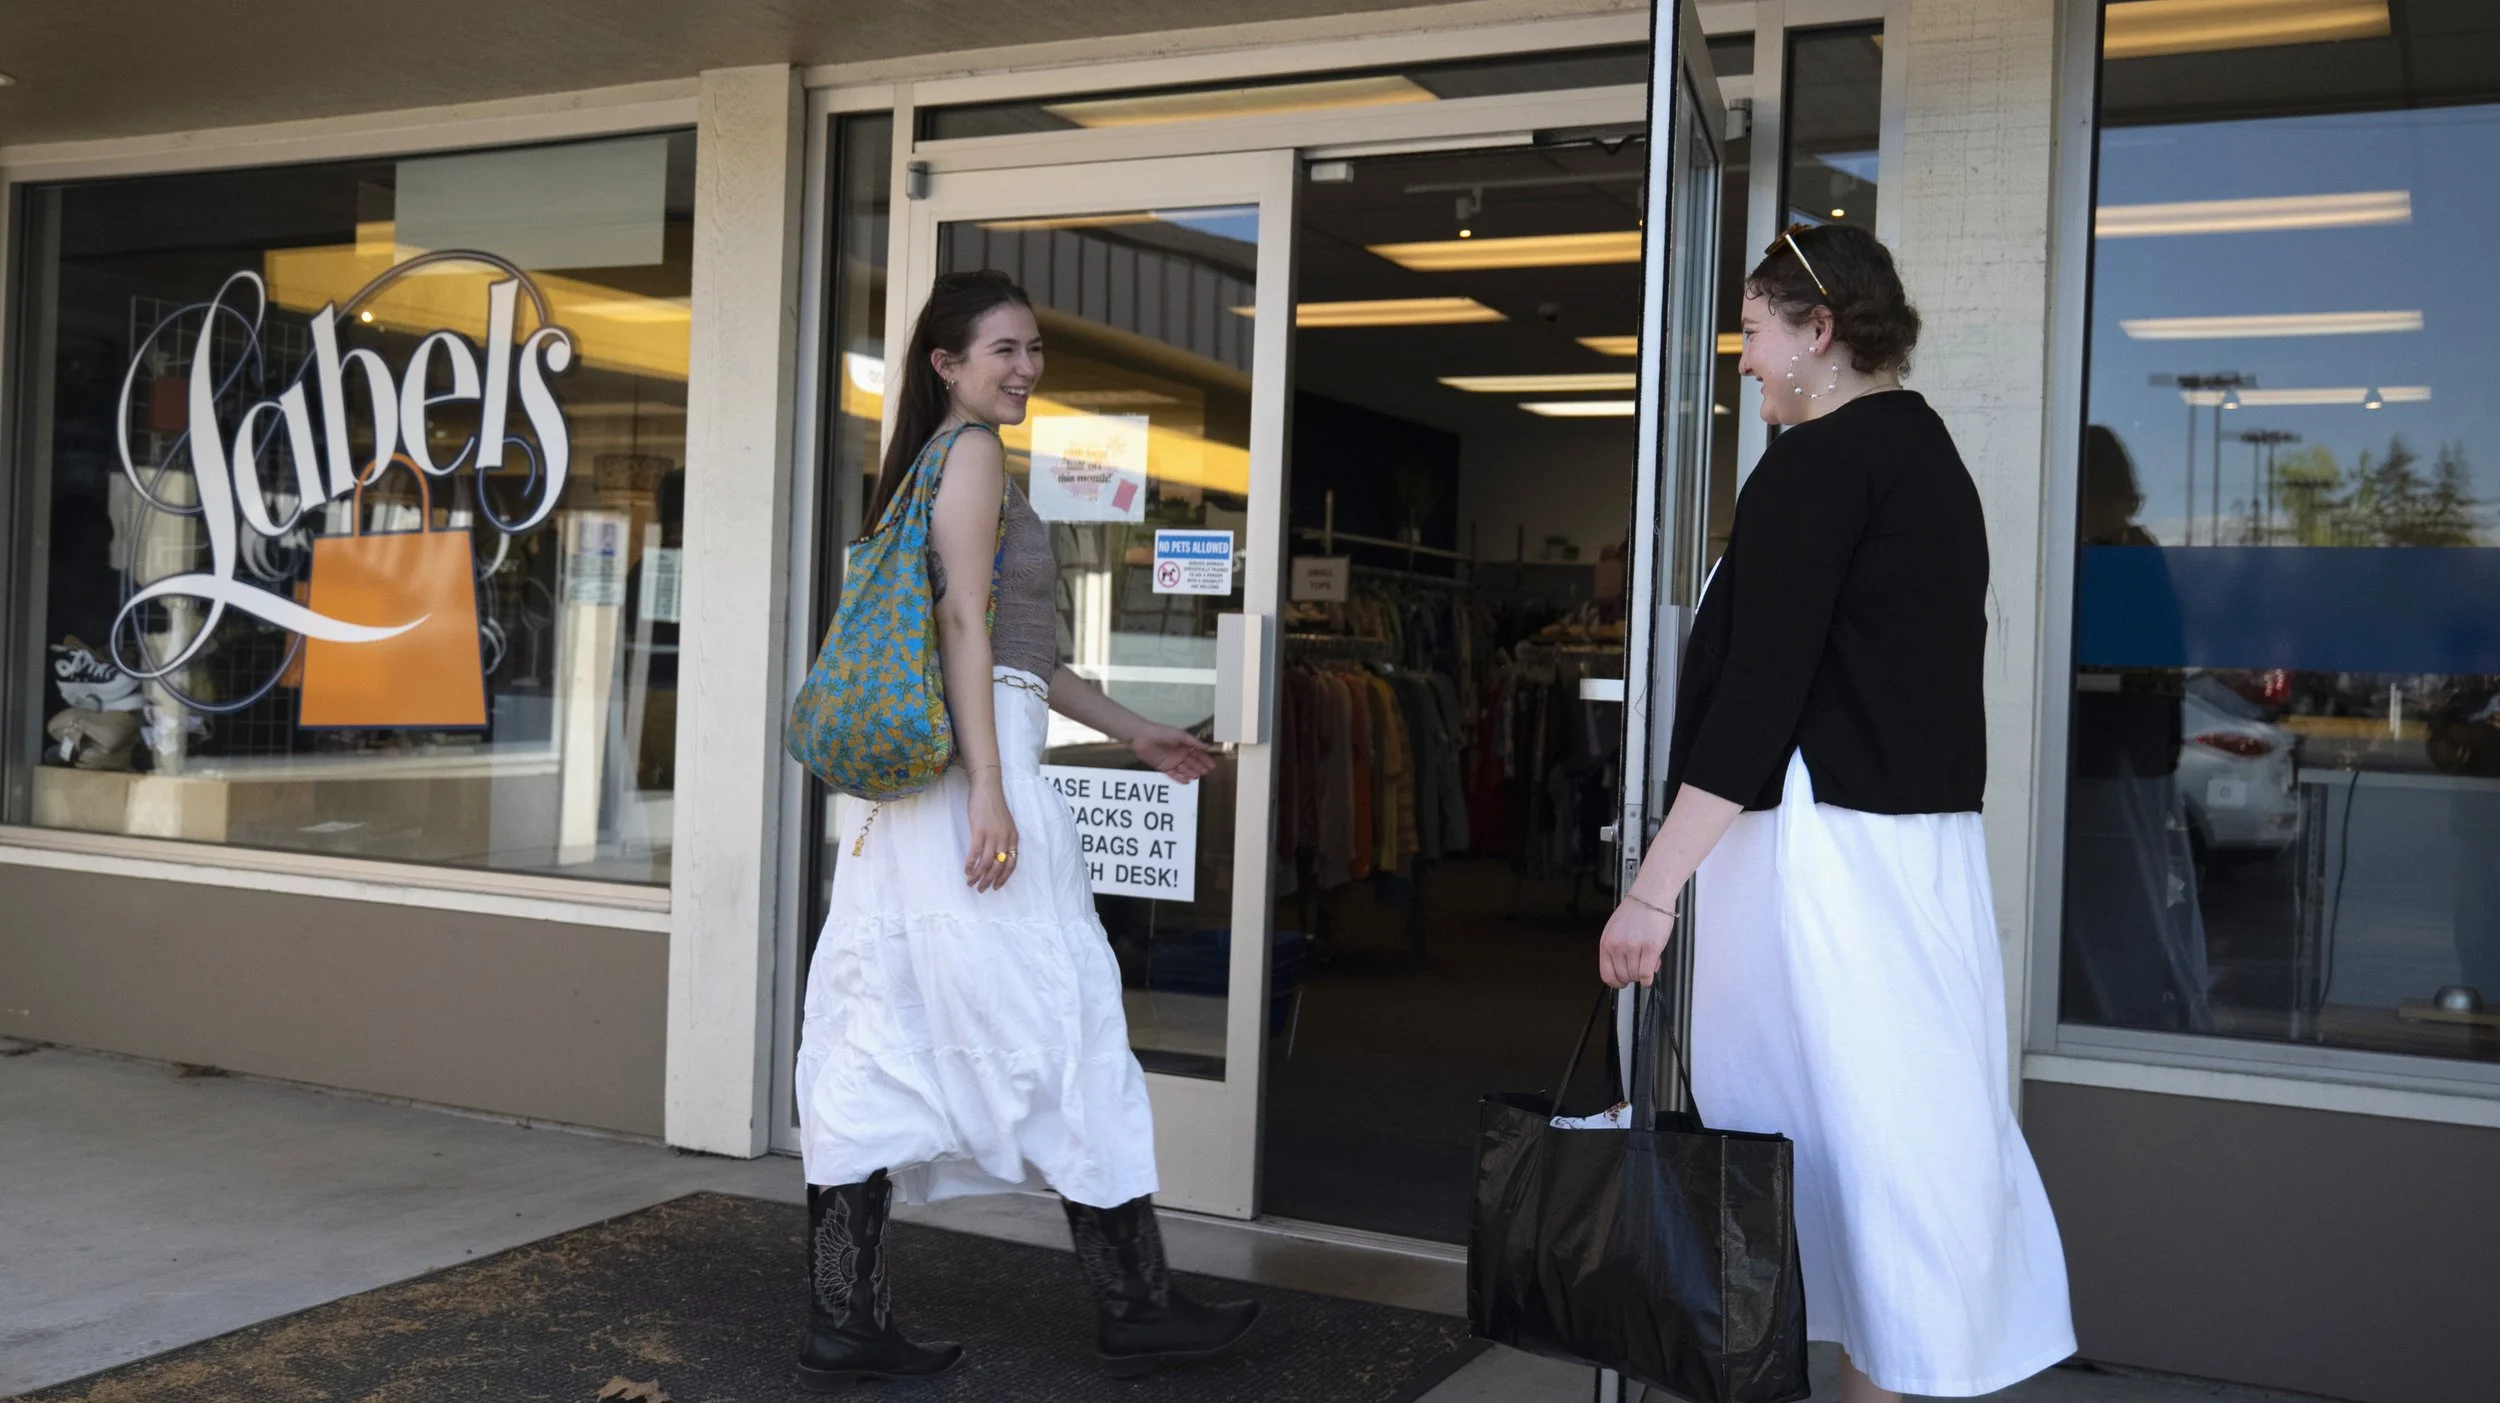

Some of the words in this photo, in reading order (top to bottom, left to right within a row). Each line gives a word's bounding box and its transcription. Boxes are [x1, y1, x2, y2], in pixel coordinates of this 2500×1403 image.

[112, 269, 573, 677] Labels
[1158, 541, 1170, 553] NO
[1171, 541, 1191, 553] PETS
[1191, 541, 1229, 554] ALLOWED
[1045, 777, 1090, 798] ASE
[1102, 780, 1169, 804] LEAVE
[1144, 811, 1174, 832] OR
[1081, 833, 1138, 857] BAGS
[1149, 839, 1177, 860] AT
[1086, 861, 1103, 881] H
[1115, 864, 1178, 888] DESK!
